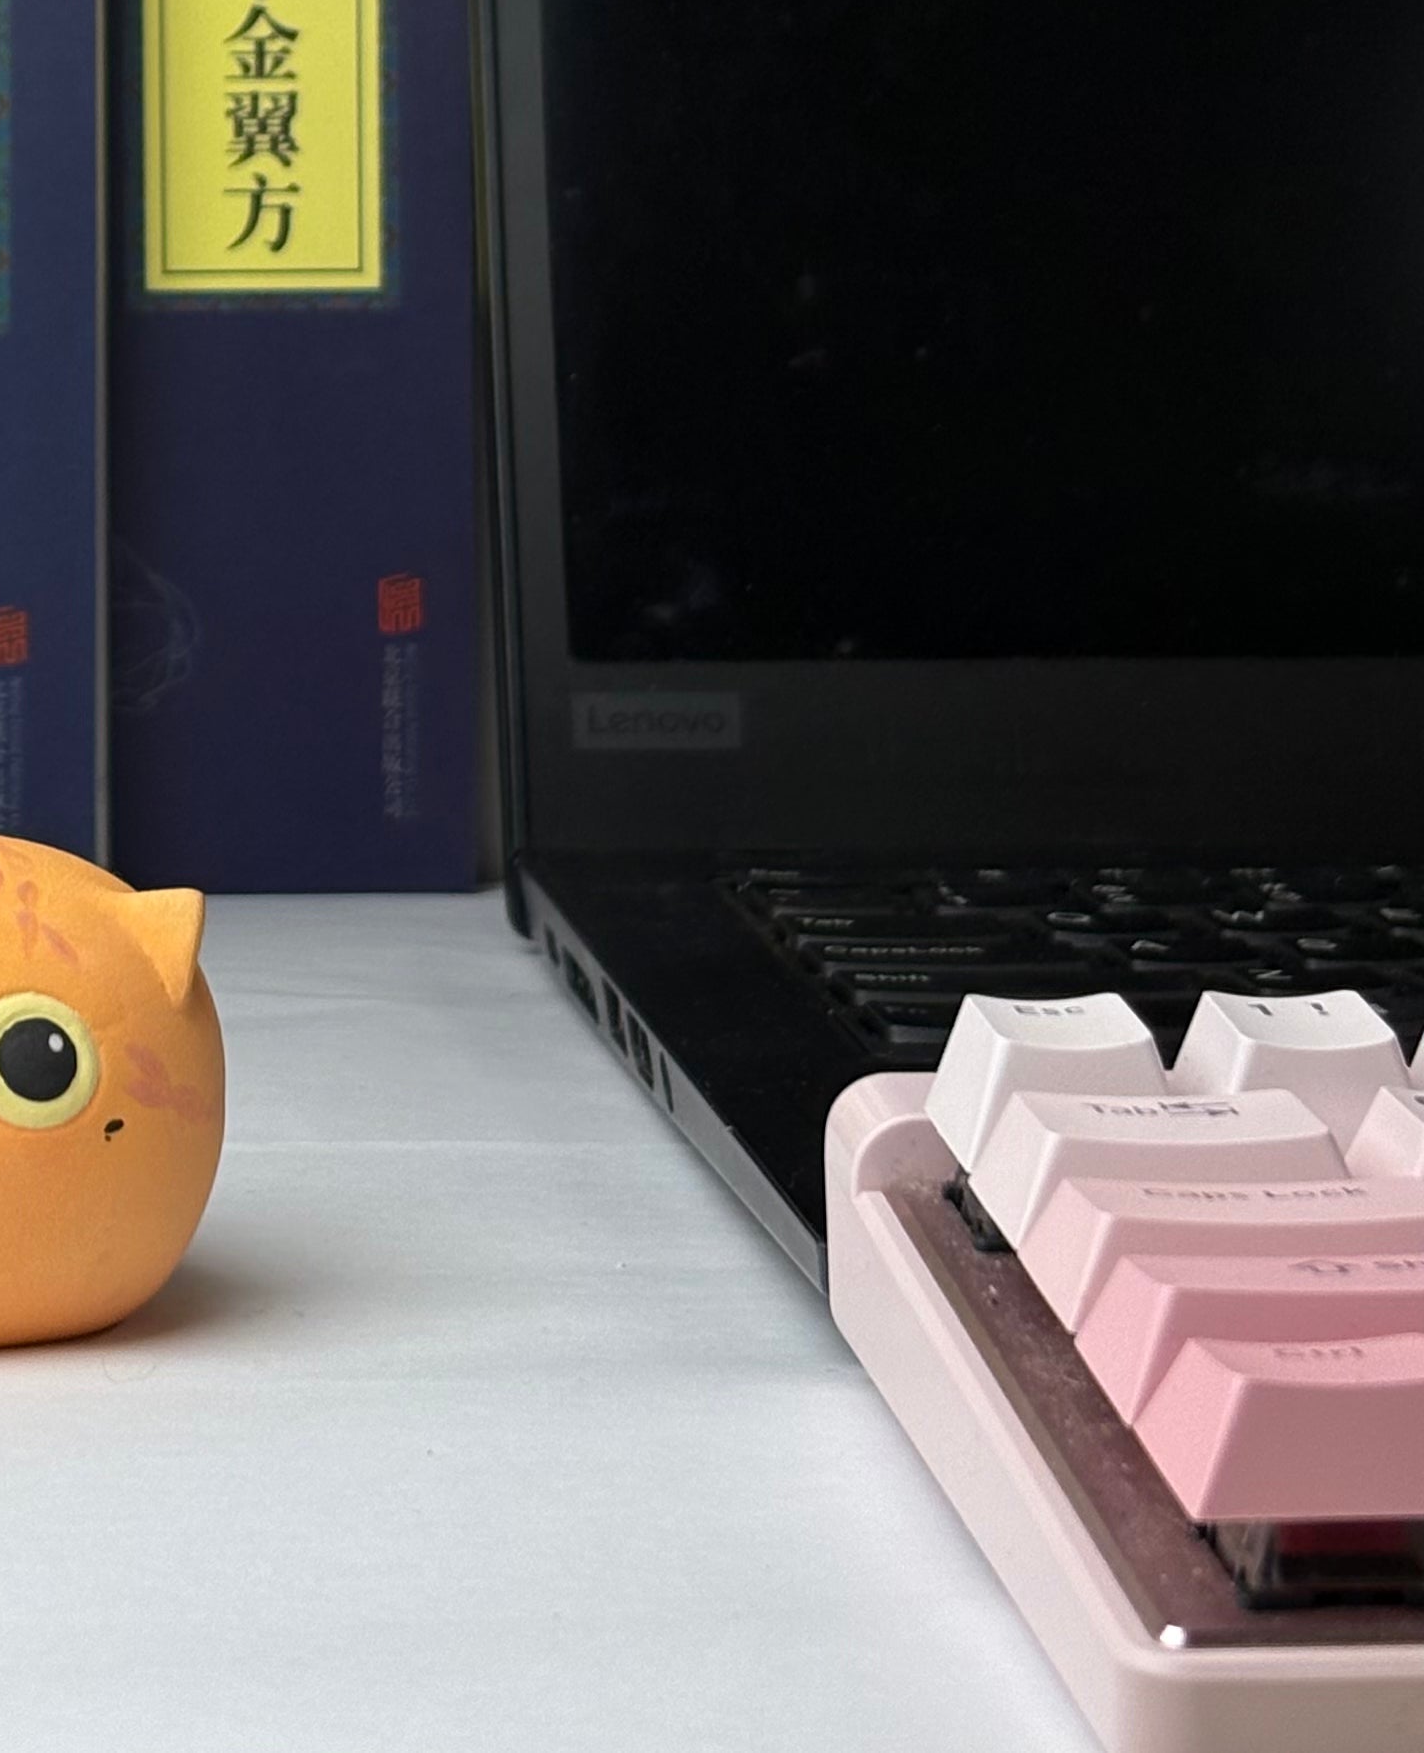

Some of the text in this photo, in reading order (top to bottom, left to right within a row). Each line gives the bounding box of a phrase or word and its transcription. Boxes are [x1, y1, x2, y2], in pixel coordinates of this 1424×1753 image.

[586, 704, 727, 734] Lenovo
[1012, 1003, 1086, 1017] Esc
[1248, 1001, 1274, 1017] 1
[1082, 1102, 1158, 1116] Tab
[1140, 1185, 1368, 1201] Caps Lock
